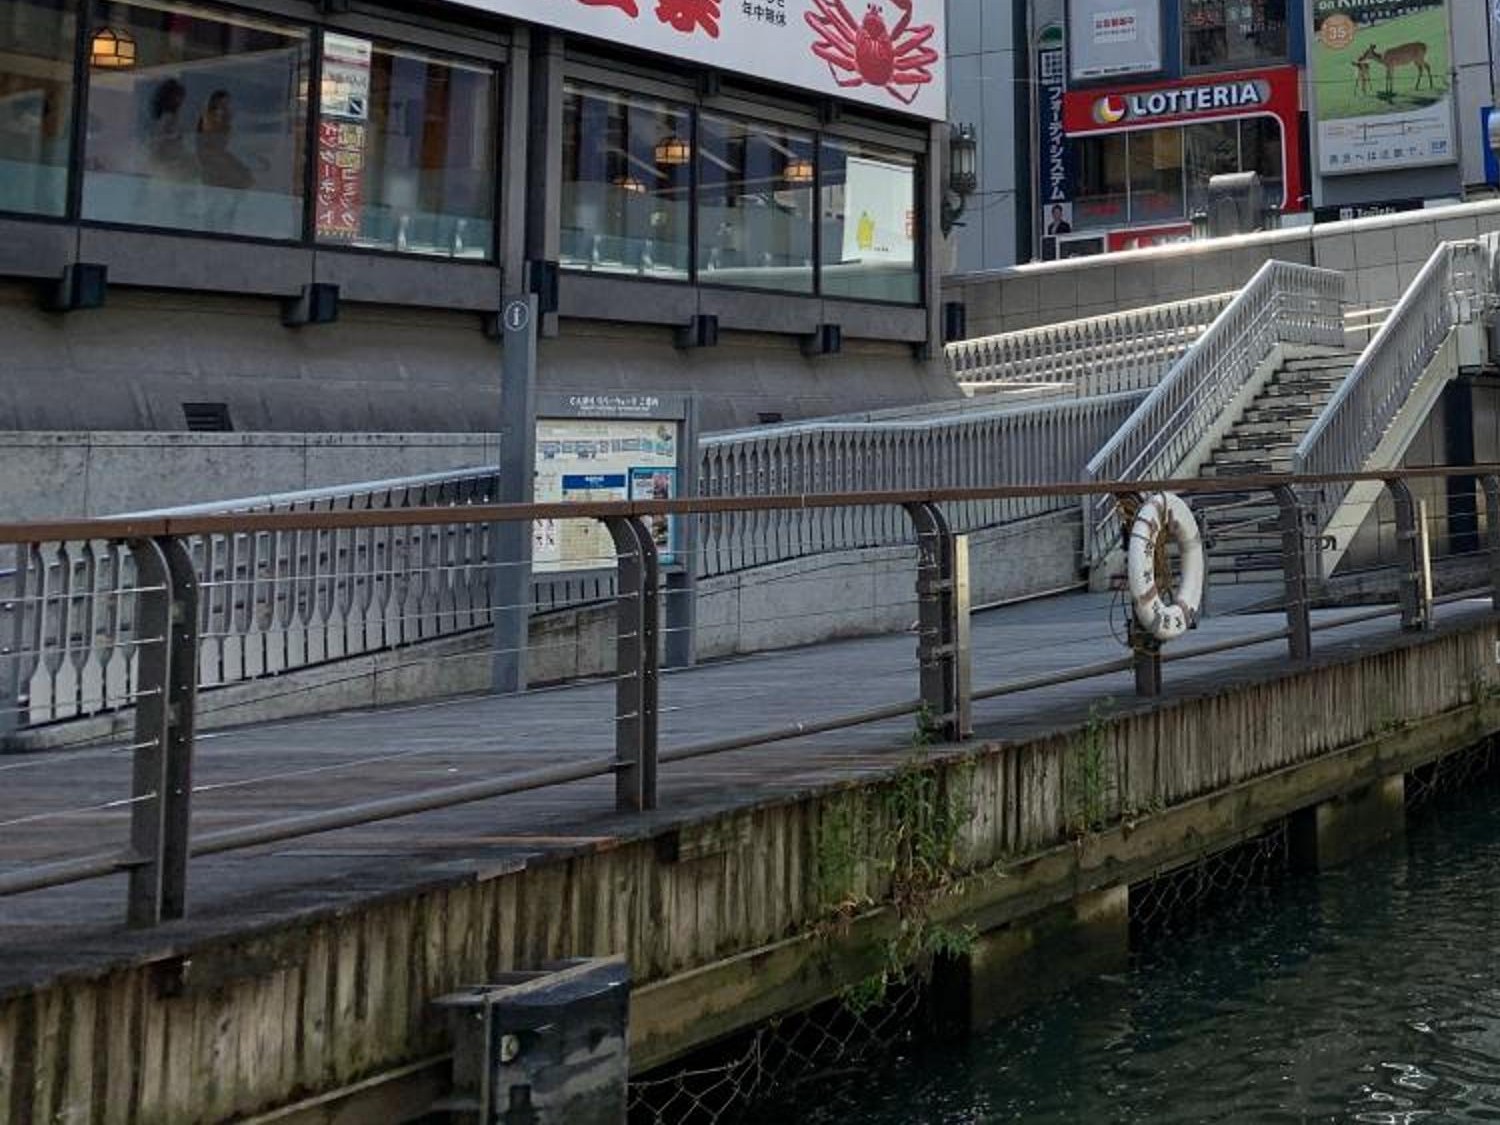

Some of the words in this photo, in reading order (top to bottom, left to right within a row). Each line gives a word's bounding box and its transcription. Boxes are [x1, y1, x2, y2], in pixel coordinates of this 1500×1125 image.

[741, 0, 787, 26] 年中無休
[1319, 0, 1335, 10] on
[1131, 83, 1260, 116] LOTTERIA
